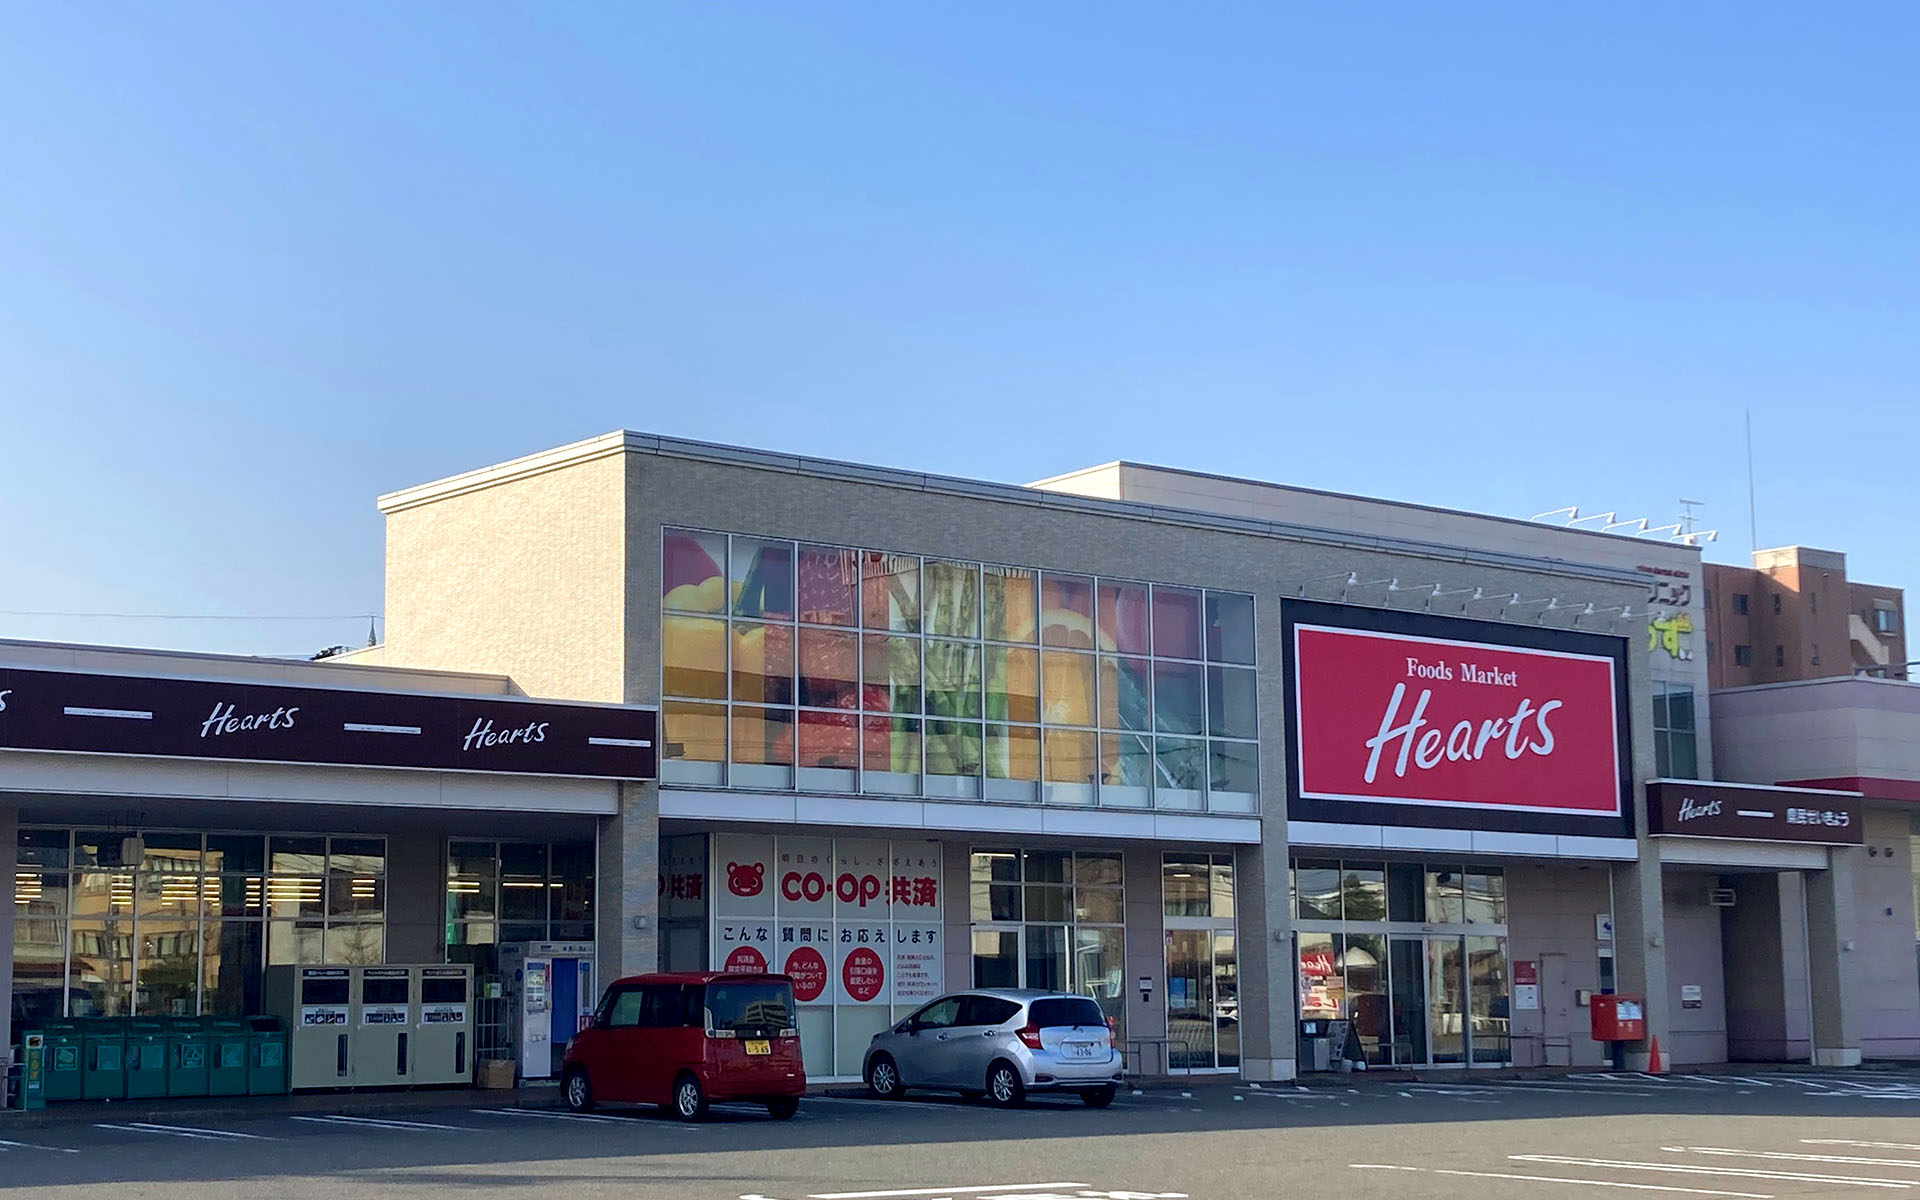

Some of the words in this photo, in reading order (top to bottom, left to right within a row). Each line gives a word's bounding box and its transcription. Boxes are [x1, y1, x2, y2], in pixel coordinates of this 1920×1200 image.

[1406, 657, 1453, 681] Foods
[1460, 662, 1518, 687] Market
[200, 701, 300, 738] Hearts
[463, 717, 550, 751] Hearts
[1363, 682, 1563, 784] Hearts
[1677, 797, 1722, 822] Hearts
